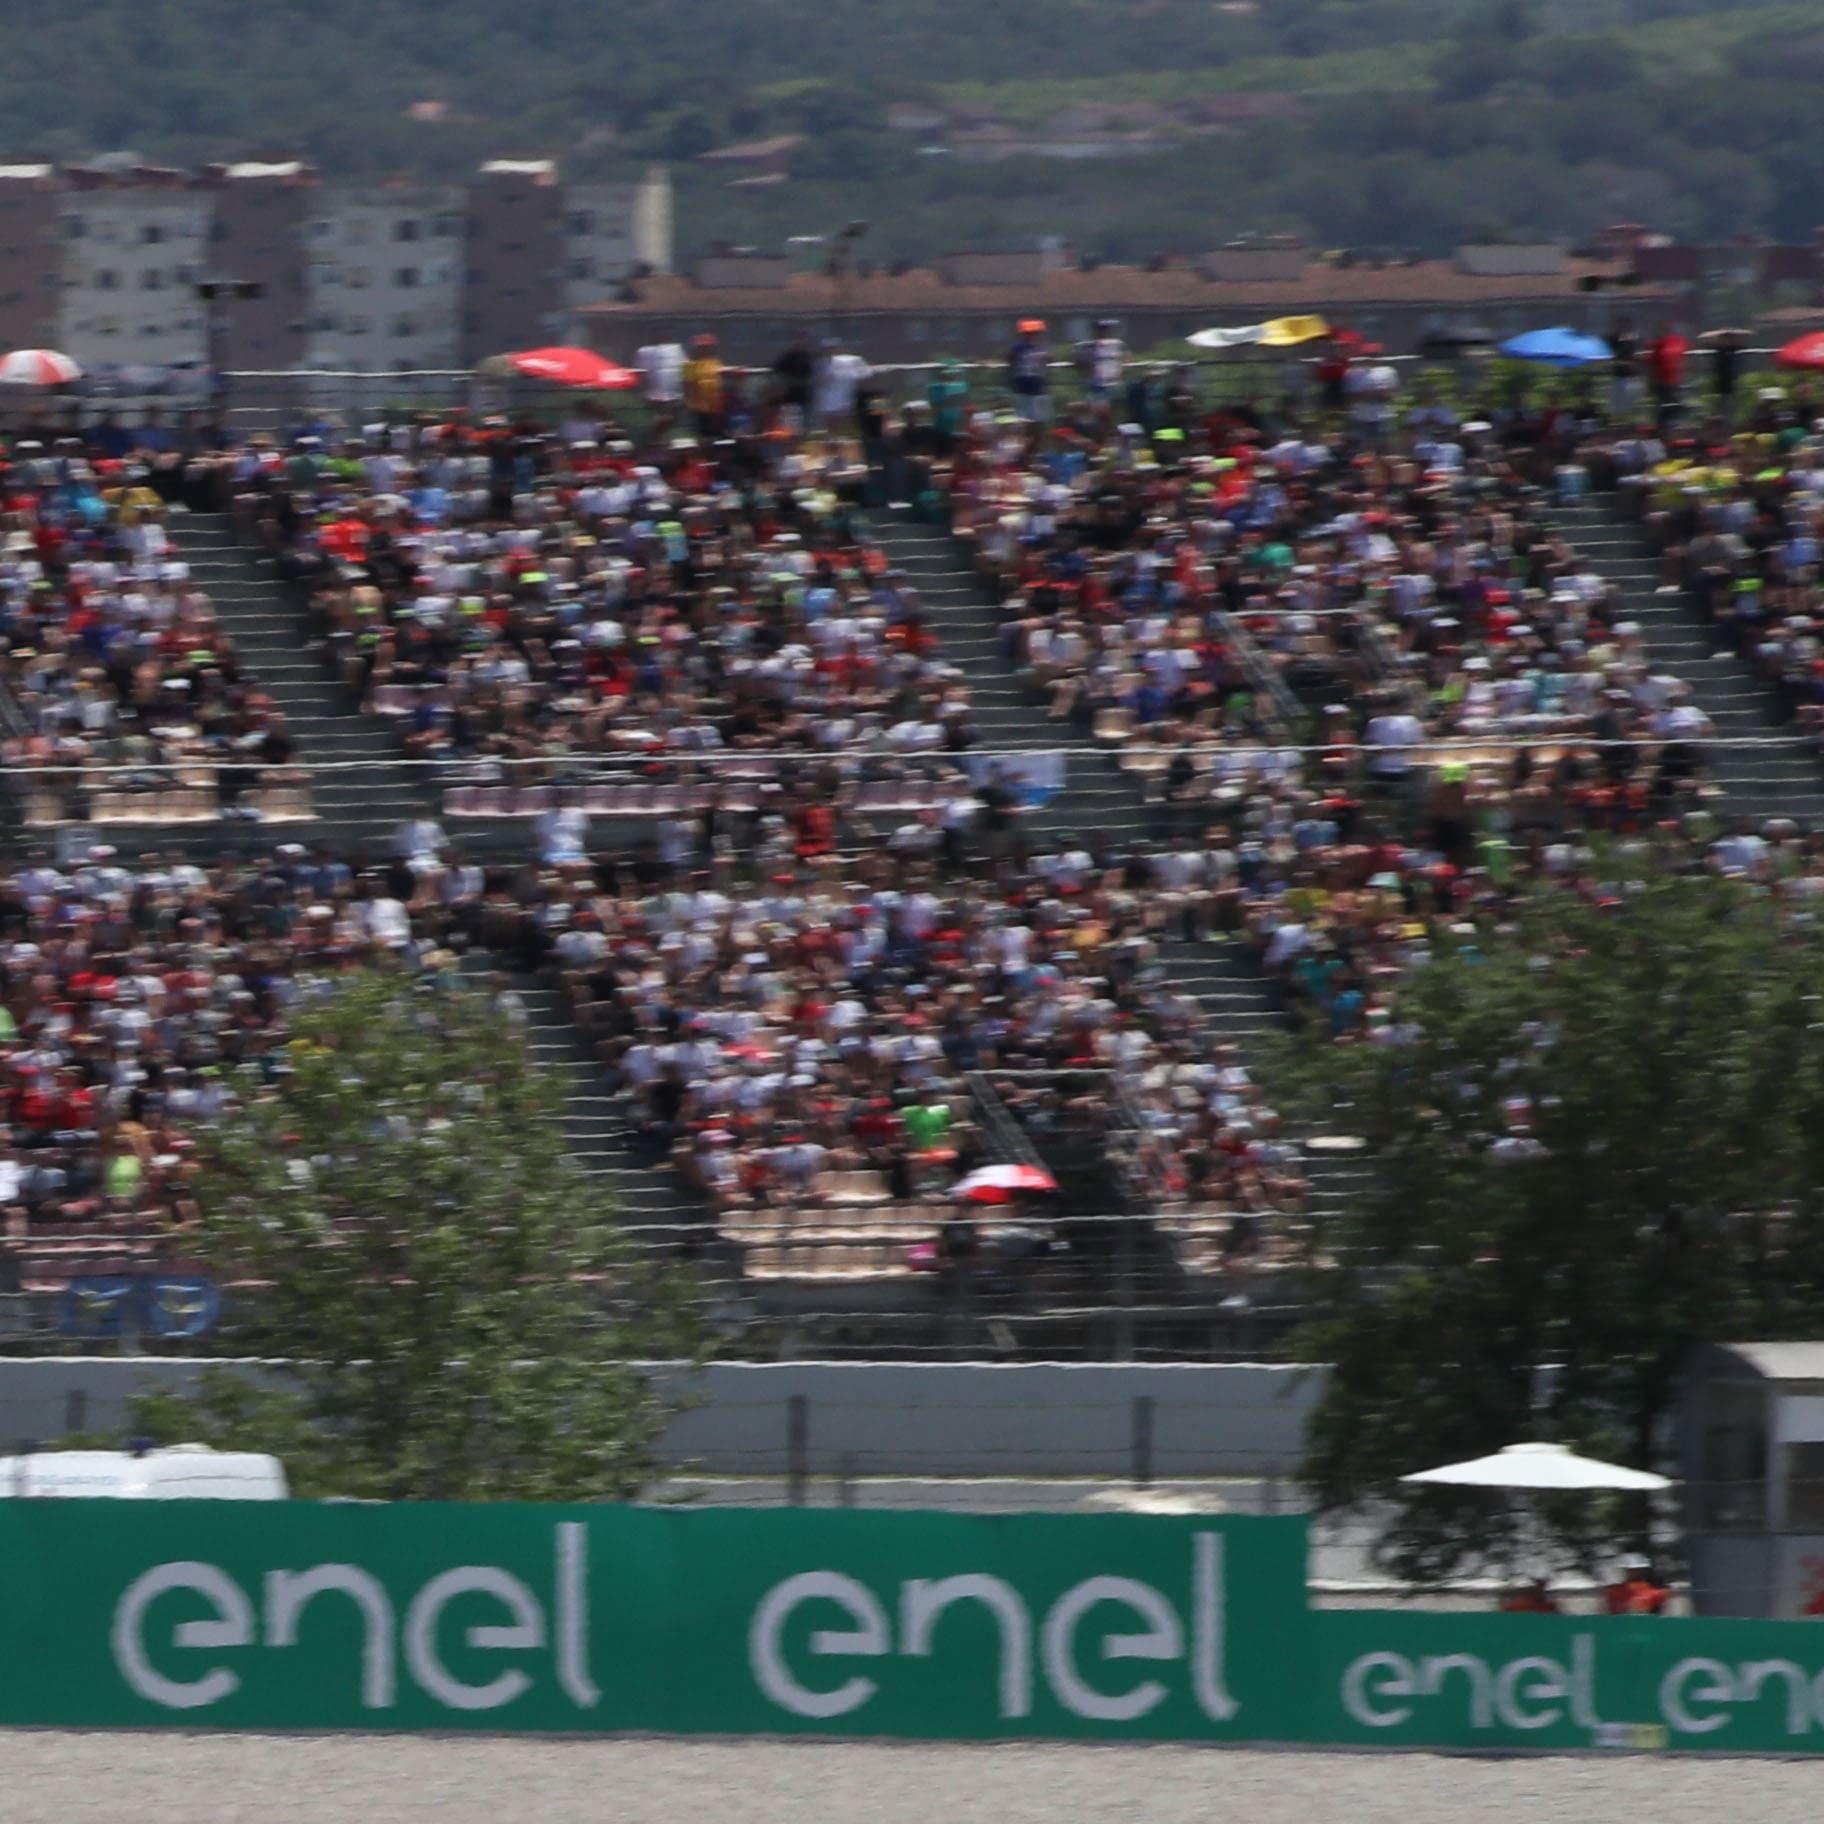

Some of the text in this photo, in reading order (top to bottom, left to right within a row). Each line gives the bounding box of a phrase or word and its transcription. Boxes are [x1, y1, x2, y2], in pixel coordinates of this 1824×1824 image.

[114, 1522, 600, 1709] enel
[752, 1532, 1238, 1720] enel
[1341, 1632, 1604, 1730] enel
